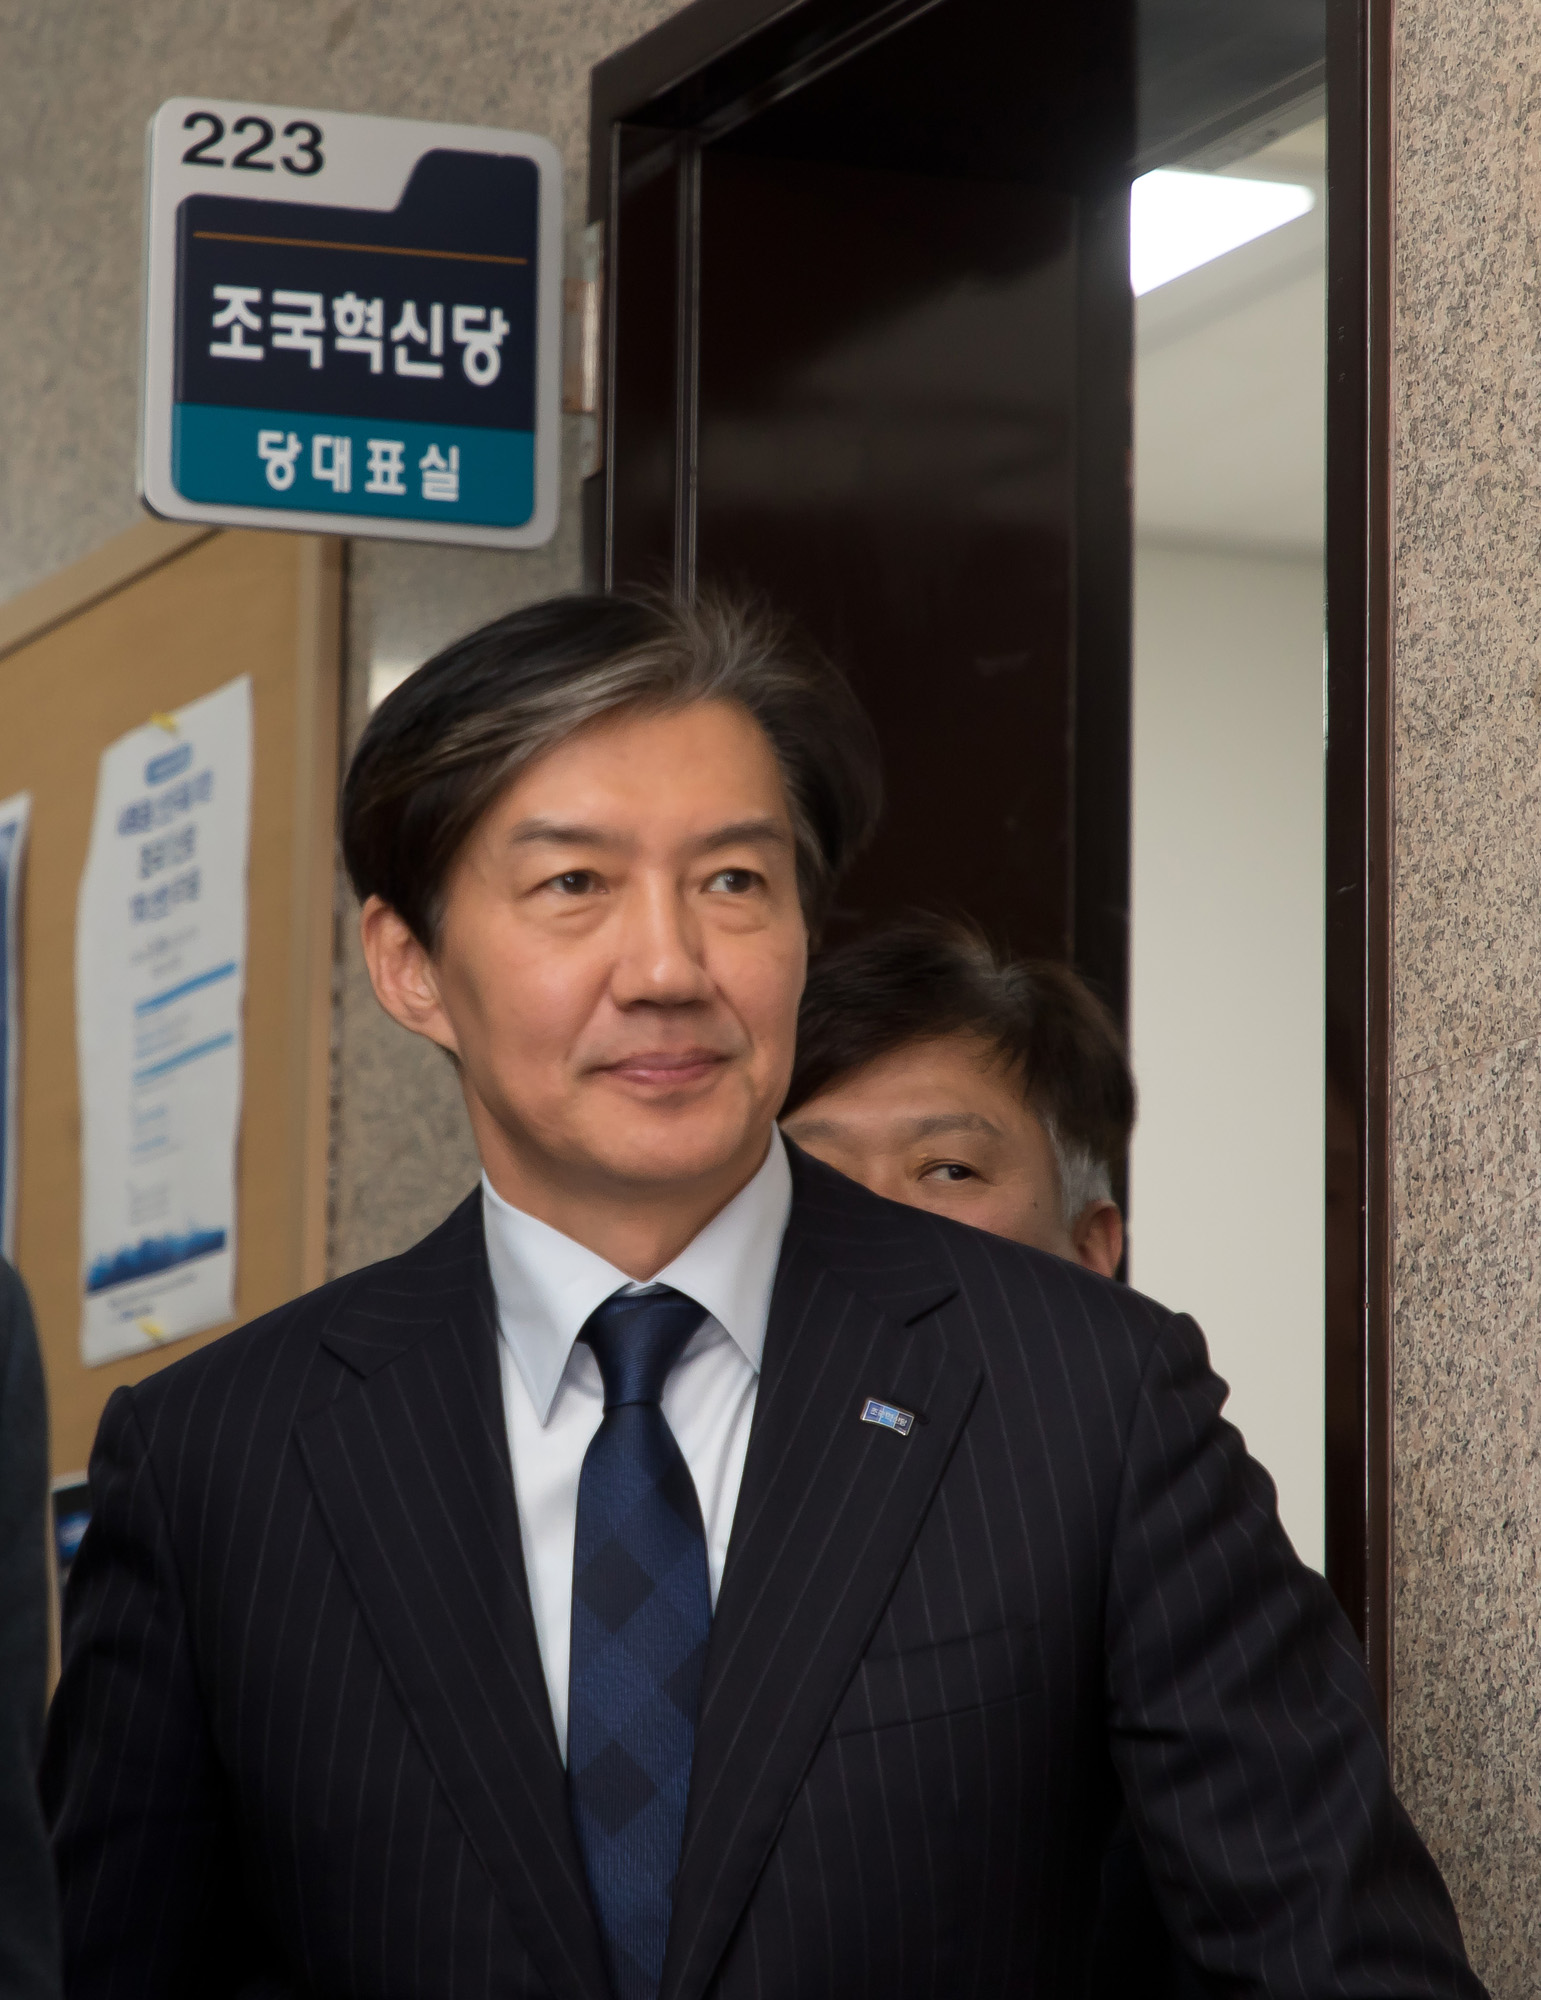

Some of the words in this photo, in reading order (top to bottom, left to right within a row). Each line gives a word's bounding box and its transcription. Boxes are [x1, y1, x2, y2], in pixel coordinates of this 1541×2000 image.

[182, 111, 325, 175] 223
[209, 284, 510, 387] 조국혁신당
[257, 430, 461, 503] 당대표실
